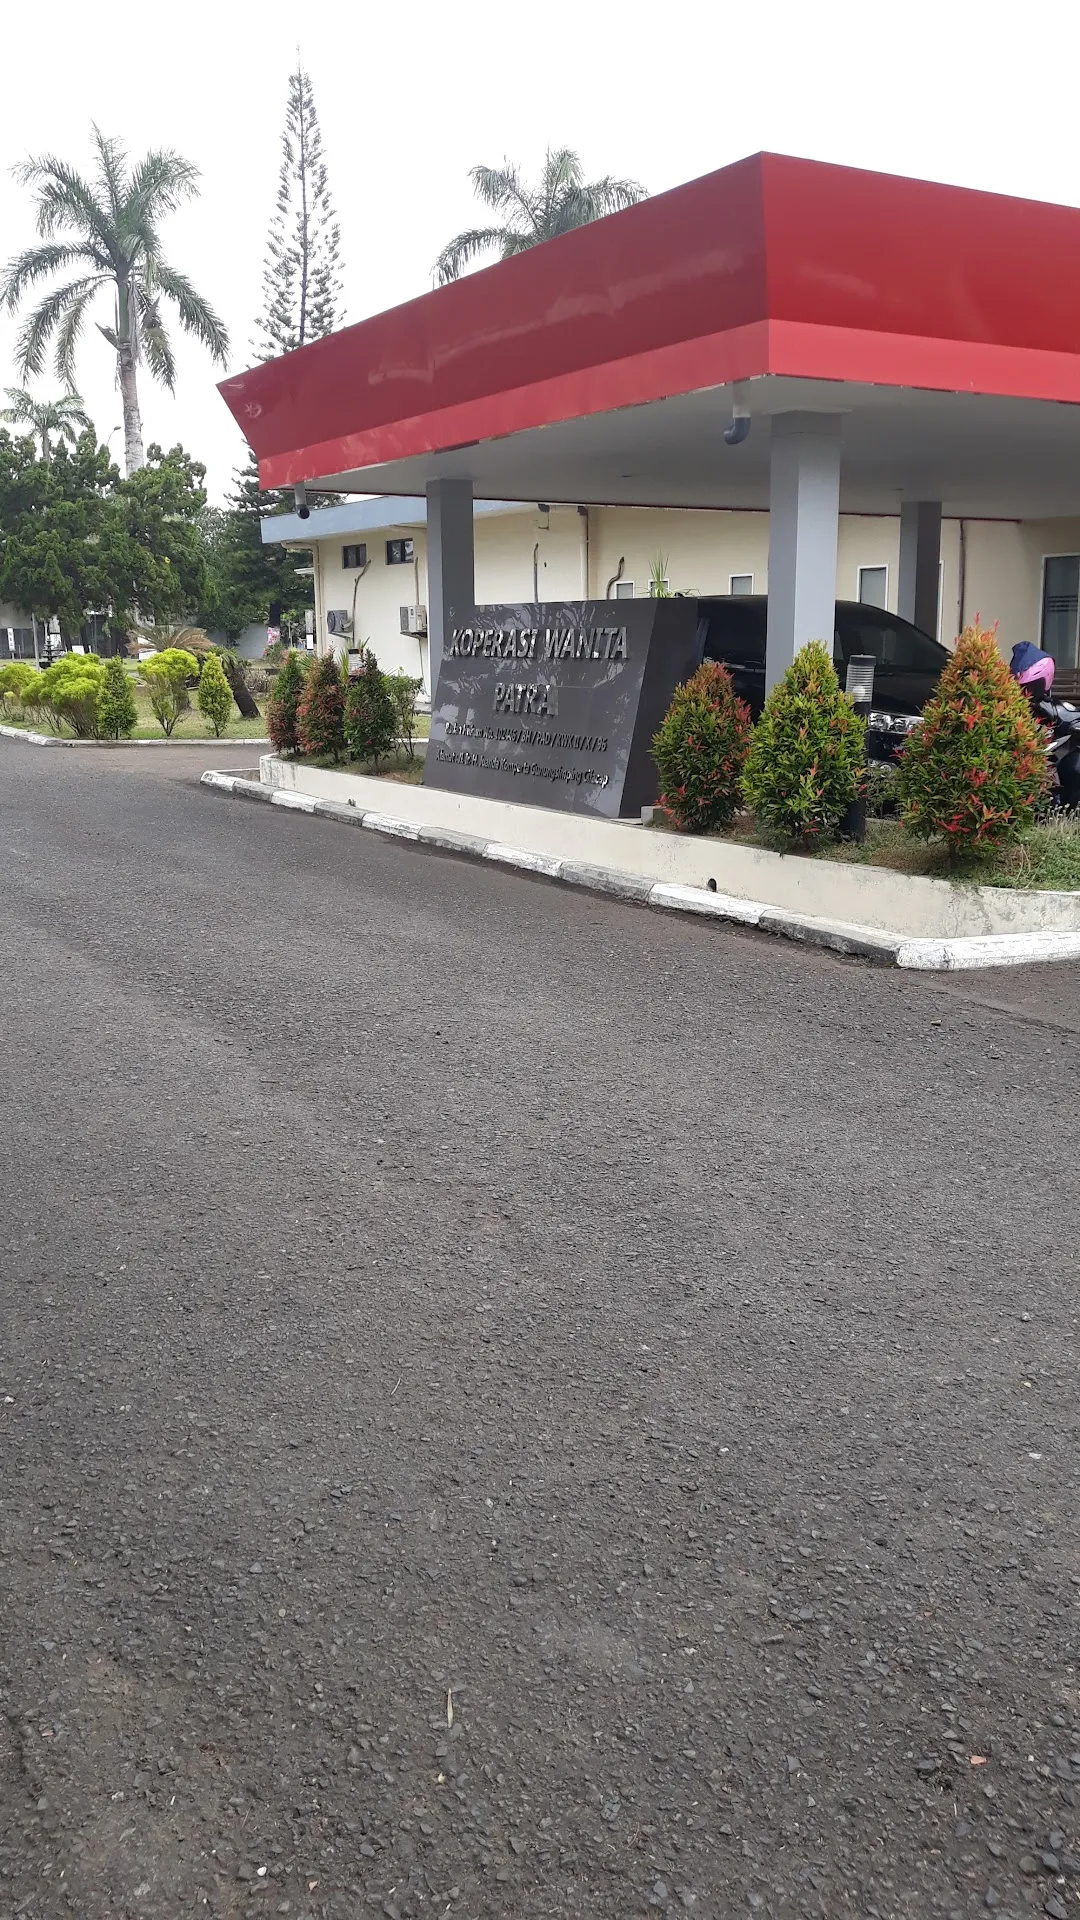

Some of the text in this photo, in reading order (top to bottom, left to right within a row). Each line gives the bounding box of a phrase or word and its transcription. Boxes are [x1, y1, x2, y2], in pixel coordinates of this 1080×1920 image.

[450, 627, 628, 658] KOPERASI WANITA
[493, 682, 558, 716] PATRA
[479, 755, 500, 770] Juanda
[584, 769, 609, 788] Cilacap
